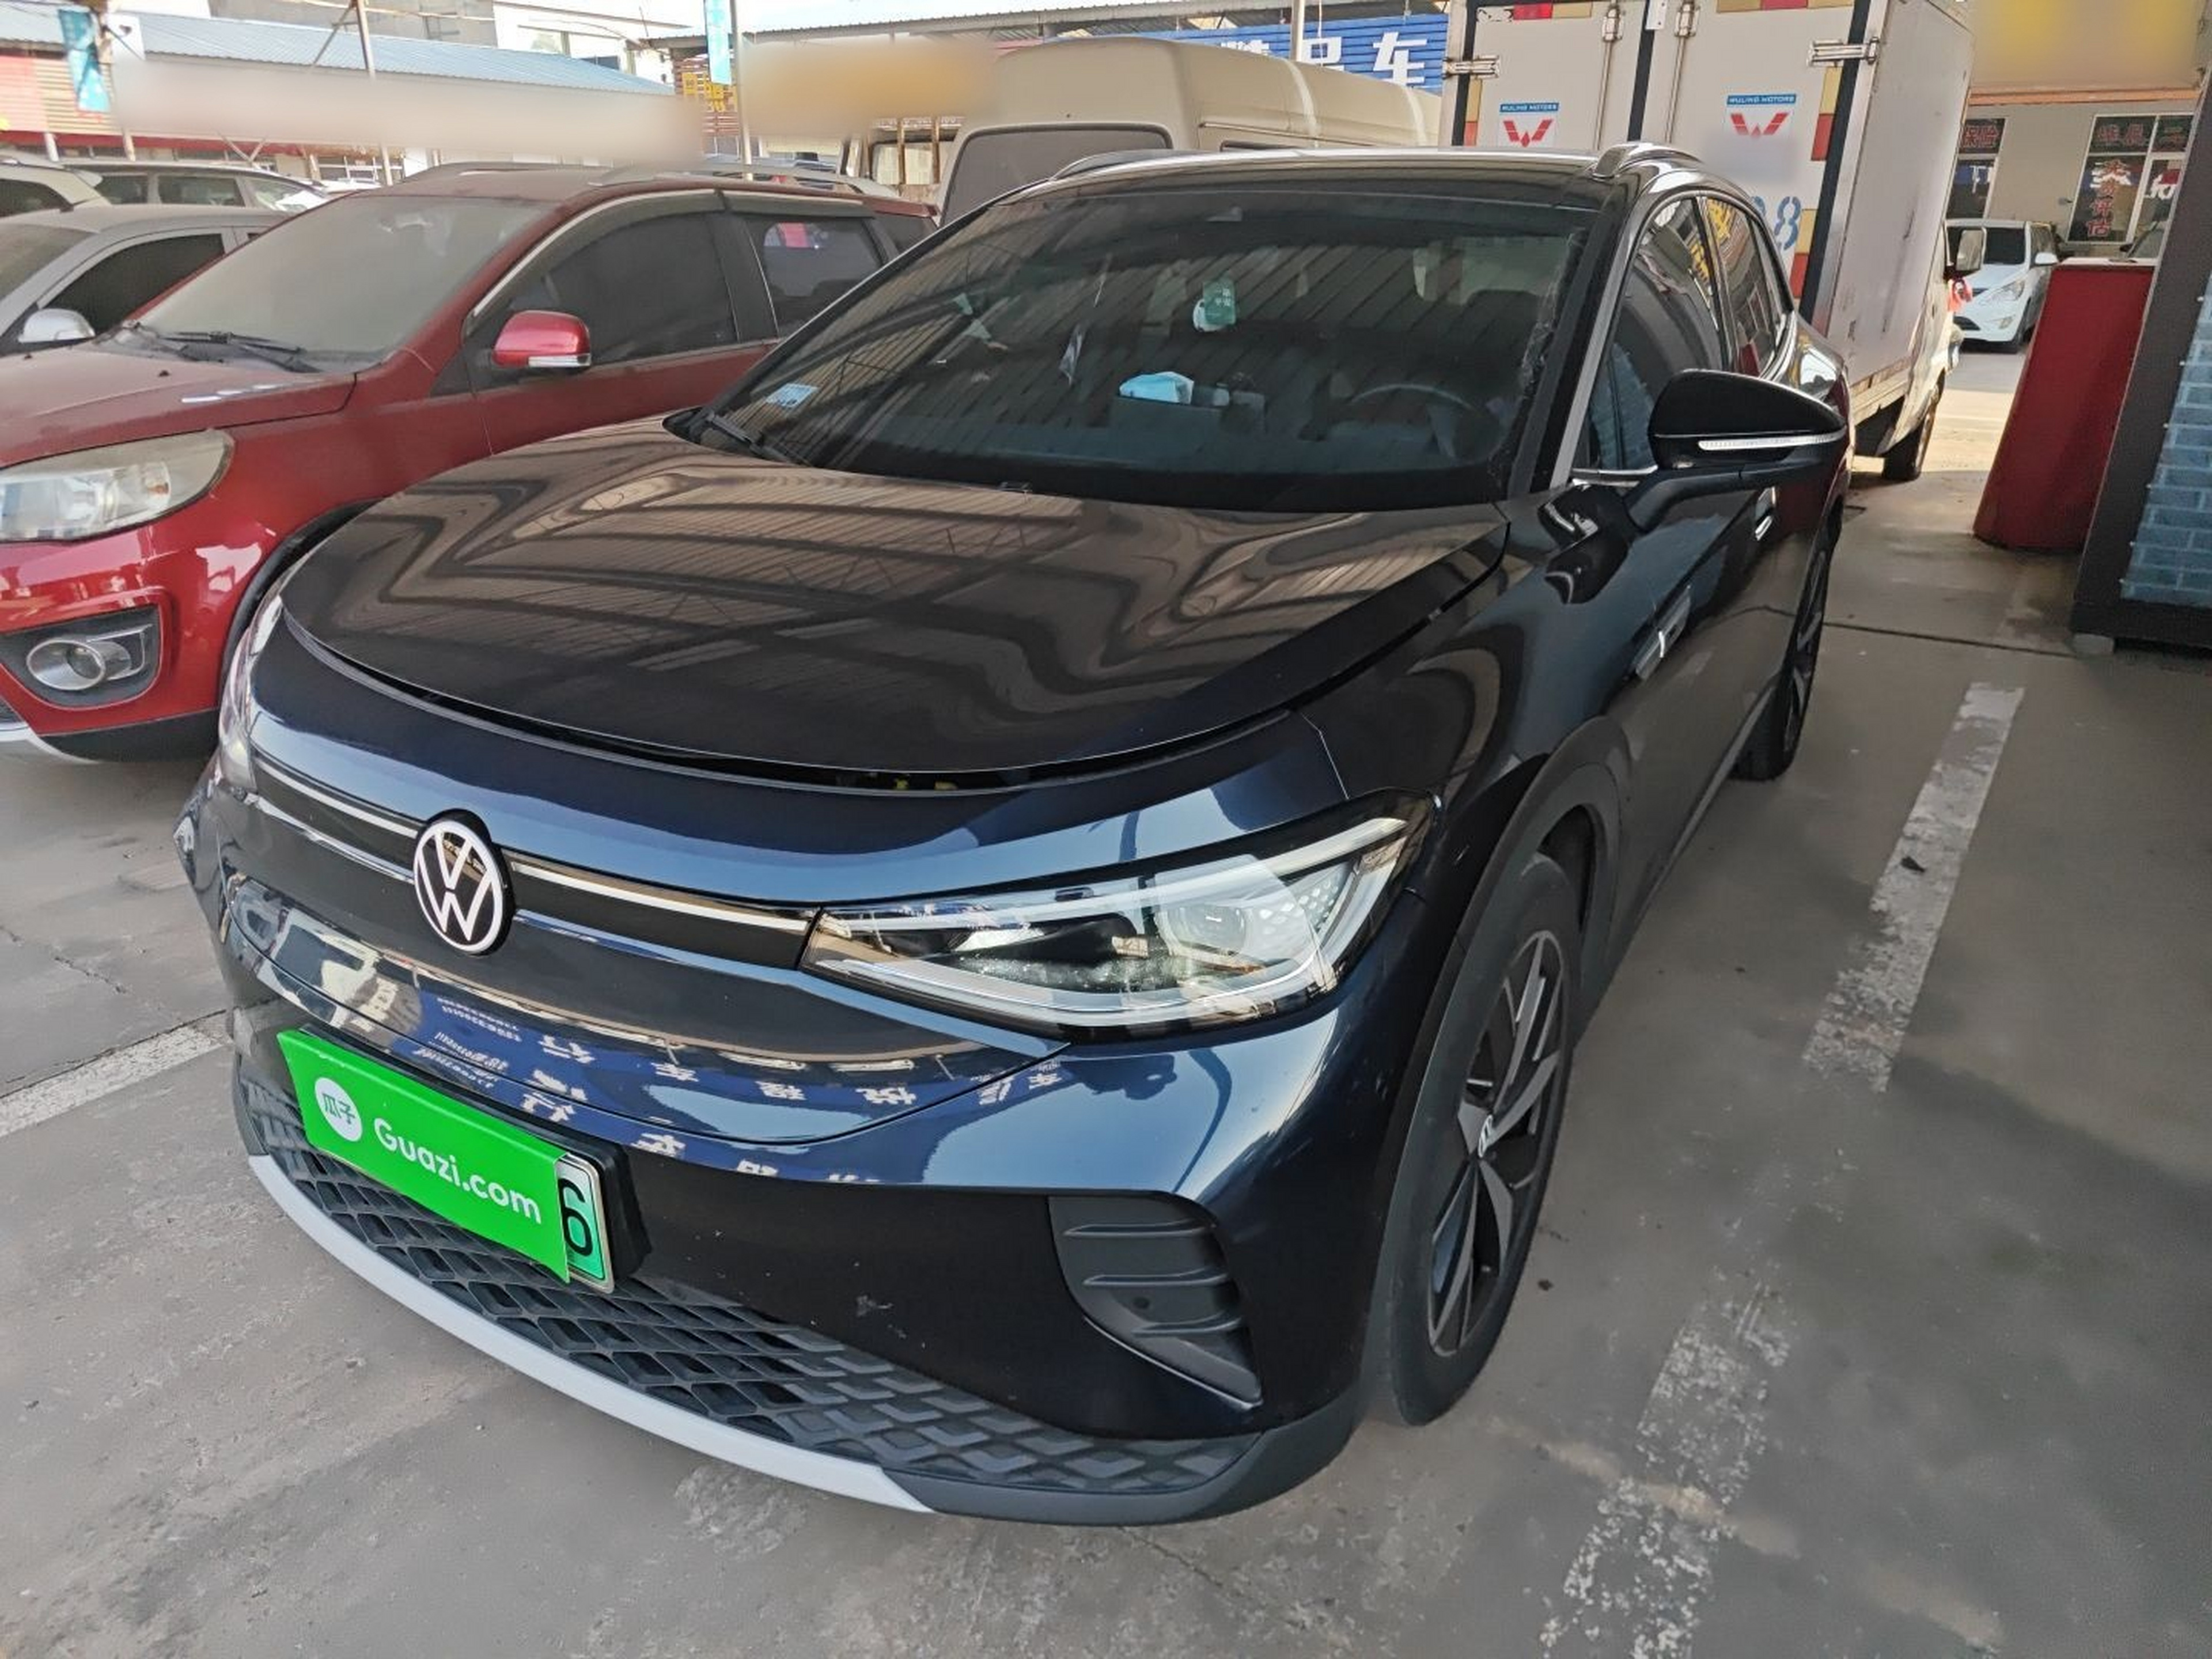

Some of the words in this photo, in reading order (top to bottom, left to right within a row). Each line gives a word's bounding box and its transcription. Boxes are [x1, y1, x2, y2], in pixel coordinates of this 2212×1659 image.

[323, 1092, 356, 1125] 瓜子
[373, 1118, 542, 1225] Guazi.com
[558, 1178, 593, 1256] 6
